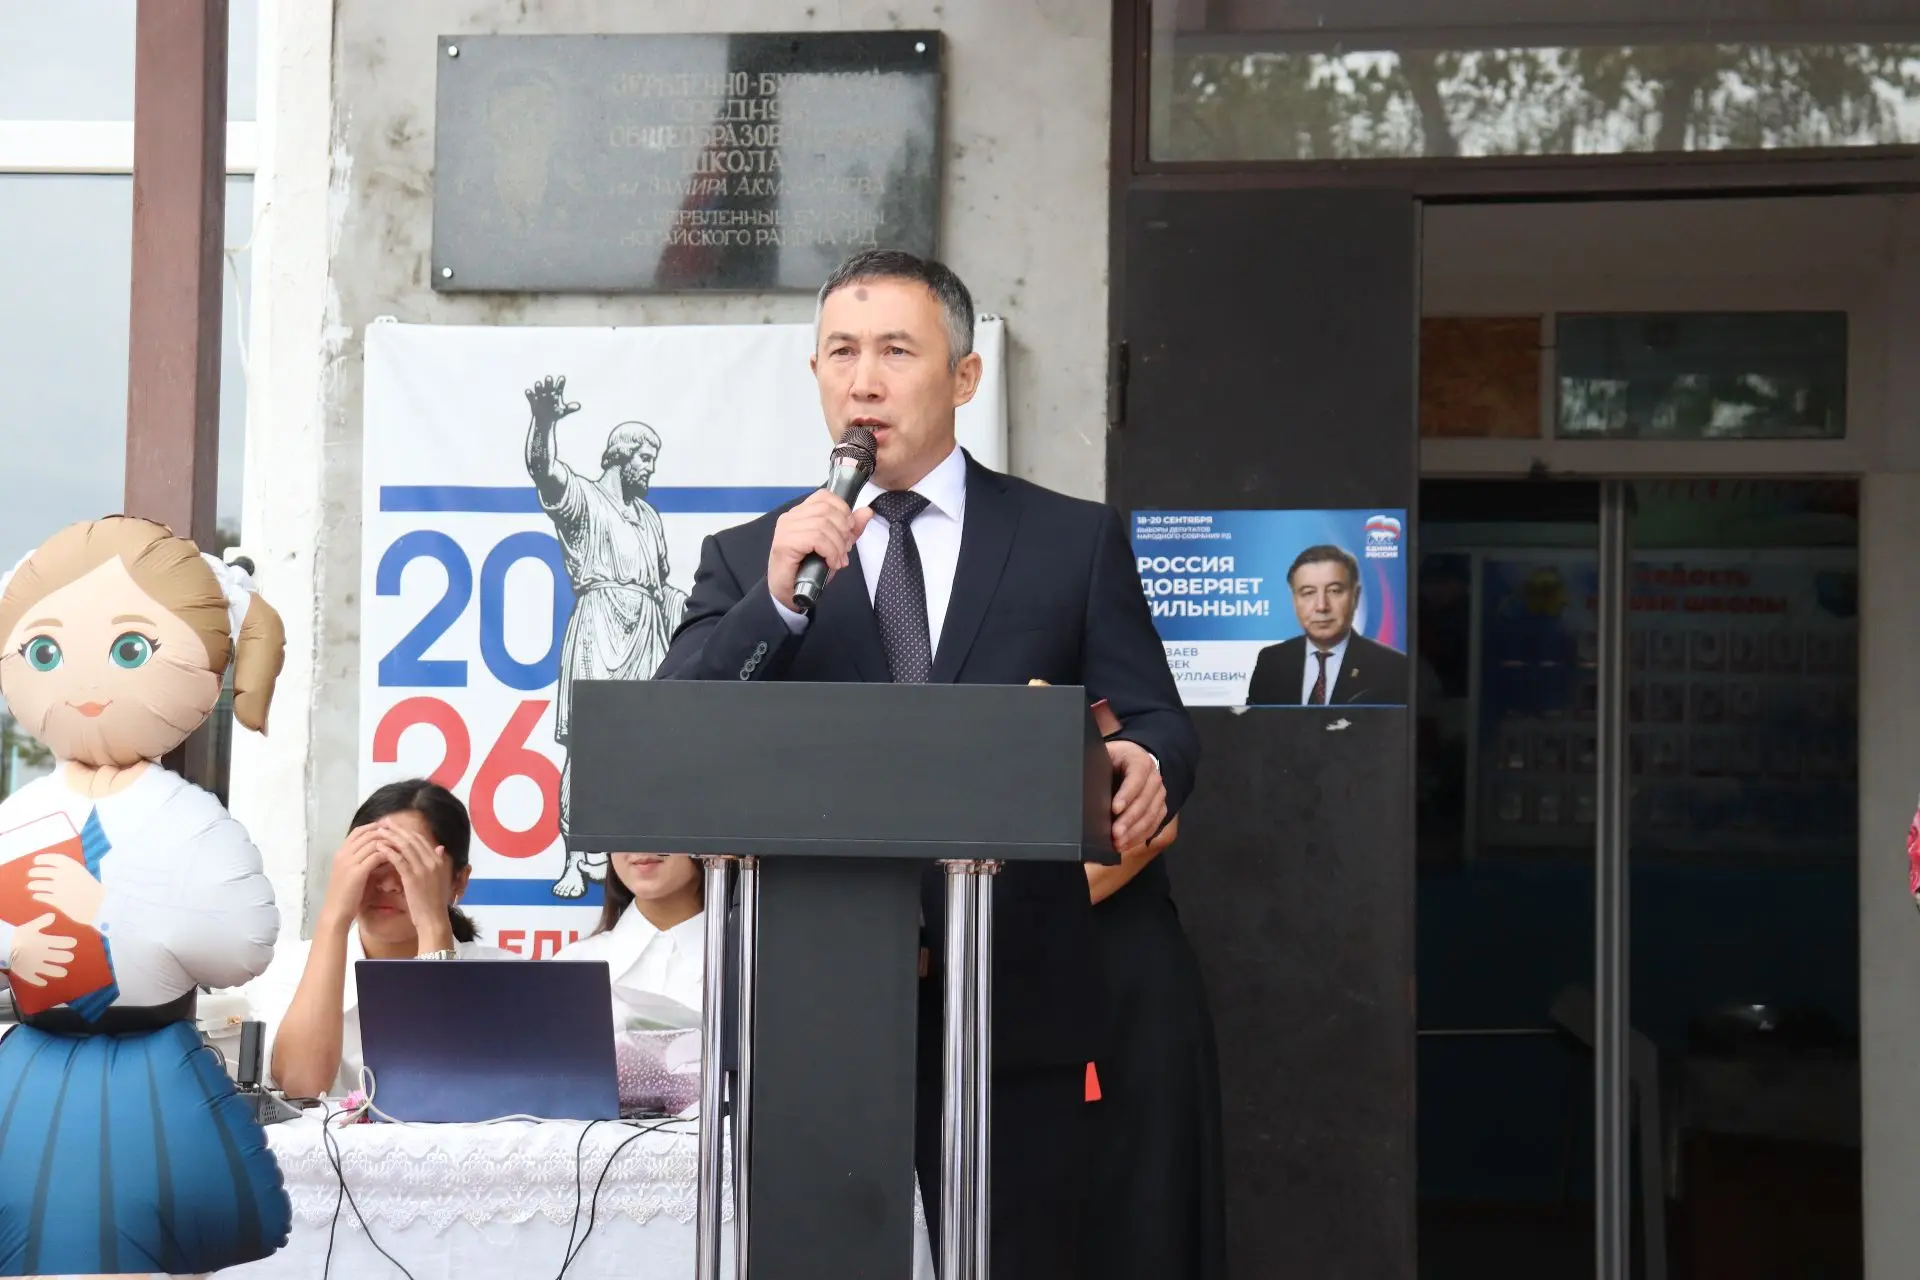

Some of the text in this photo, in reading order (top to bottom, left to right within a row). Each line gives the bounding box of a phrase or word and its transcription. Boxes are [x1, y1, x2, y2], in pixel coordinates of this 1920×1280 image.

[681, 150, 785, 174] ШКОЛА
[1163, 516, 1213, 524] СЕНТЯБРЯ
[1137, 556, 1235, 573] РОССИЯ
[1141, 577, 1263, 598] ДОВЕРЯЕТ
[376, 530, 577, 691] 20
[1148, 600, 1270, 617] ИЛЬНЫМ!
[1165, 648, 1199, 657] ЗАЕВ
[1167, 660, 1190, 669] БЕК
[1173, 672, 1247, 681] УЛЛАЕВИЧ
[373, 696, 563, 859] 26
[498, 930, 579, 961] ЕД
